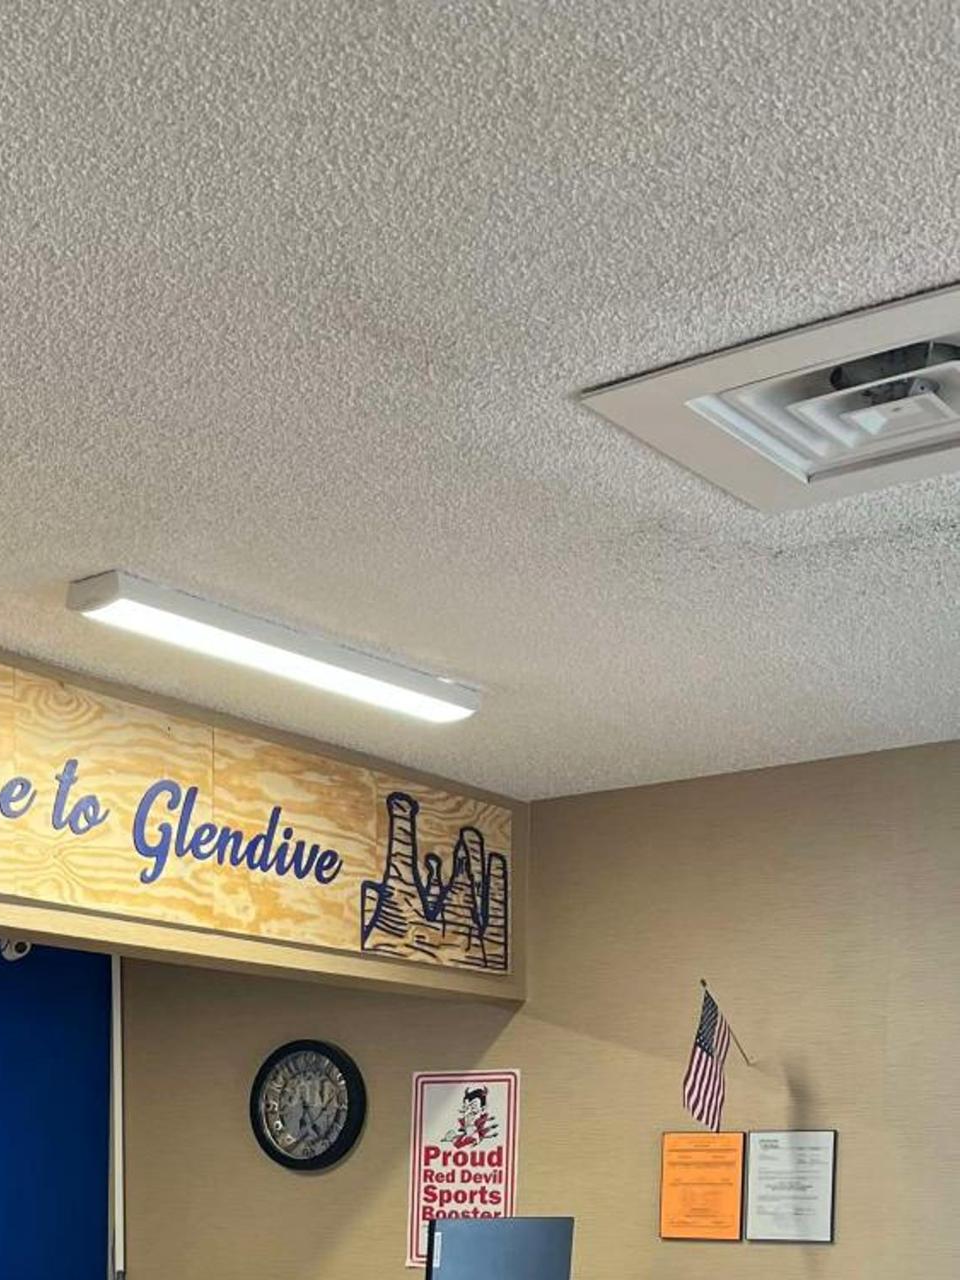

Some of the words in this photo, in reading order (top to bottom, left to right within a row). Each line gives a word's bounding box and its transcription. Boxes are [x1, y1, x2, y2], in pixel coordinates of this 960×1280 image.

[51, 759, 109, 835] to
[132, 778, 343, 884] Glendive
[423, 1146, 503, 1167] Proud
[423, 1169, 456, 1184] Red
[460, 1169, 503, 1184] Devil
[423, 1185, 502, 1206] Sports
[422, 1206, 501, 1221] Booster
